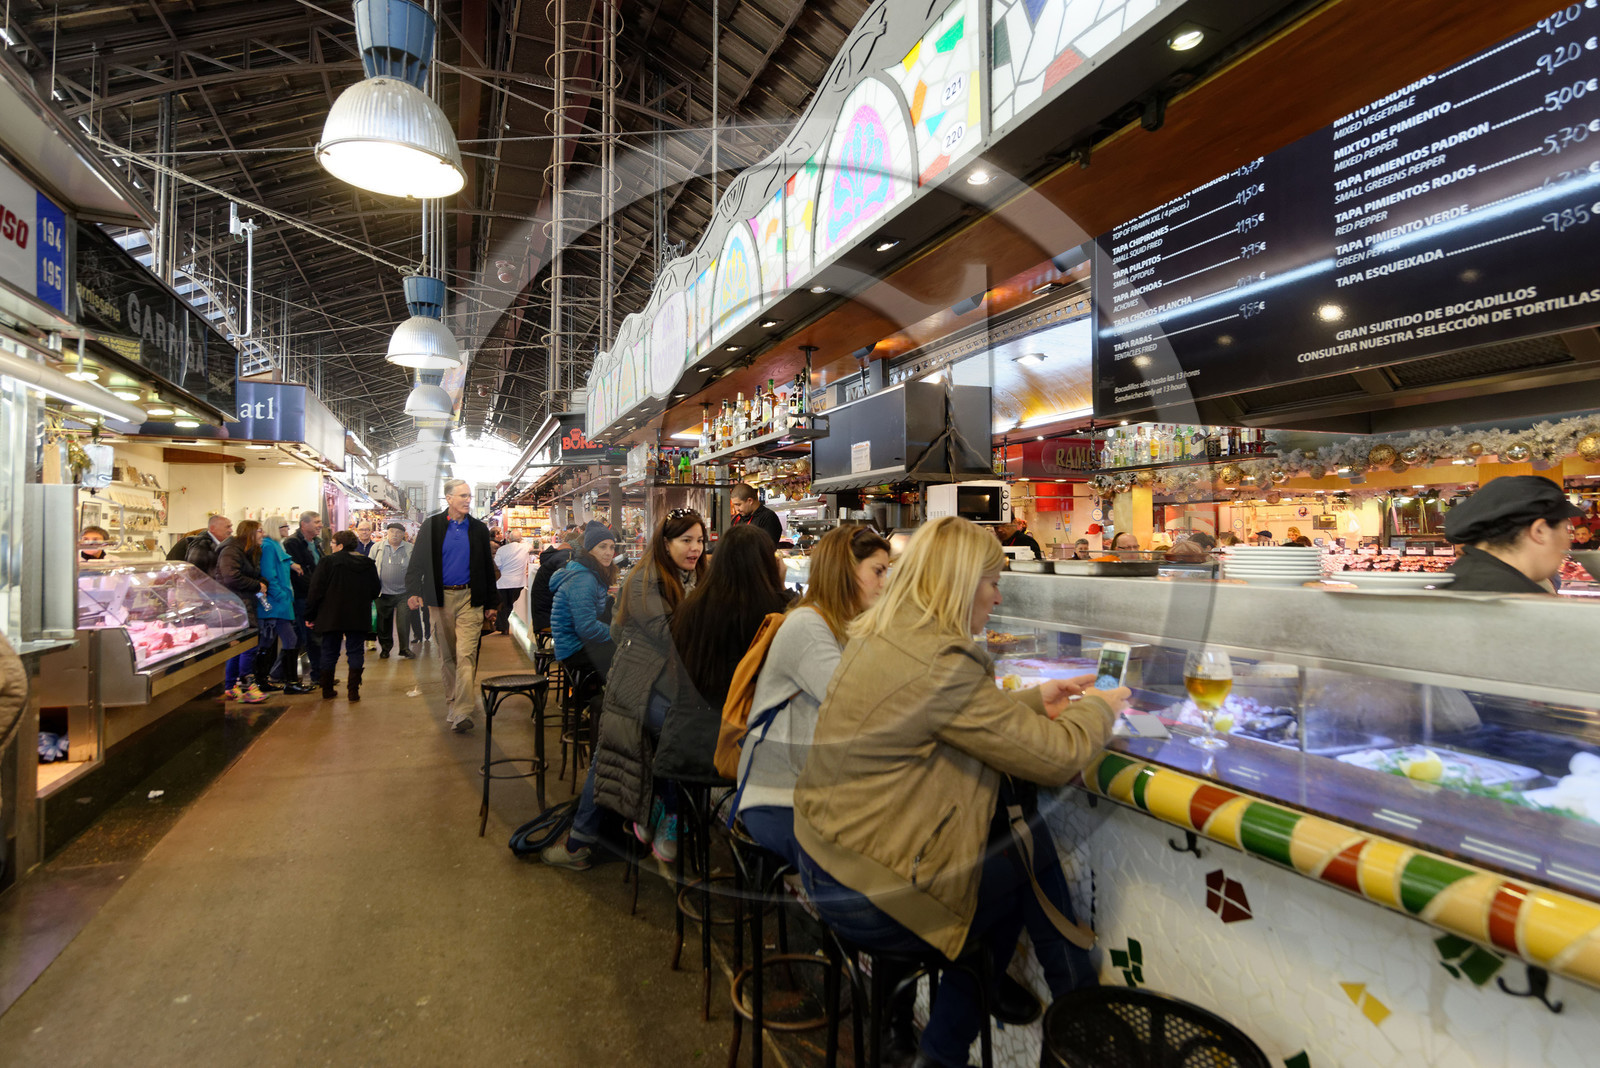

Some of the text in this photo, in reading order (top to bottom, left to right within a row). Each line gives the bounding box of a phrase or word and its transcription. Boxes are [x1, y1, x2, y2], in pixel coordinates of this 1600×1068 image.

[945, 76, 962, 101] 221
[1333, 94, 1417, 141] MIXED VEGETABLE
[1333, 137, 1371, 160] MIXTO
[1371, 128, 1389, 144] DE
[1388, 101, 1452, 136] PIMIENTO
[946, 125, 963, 148] 220
[1333, 137, 1399, 173] MIXED PEPPER
[1334, 174, 1363, 192] TAPA
[1363, 145, 1430, 181] PIMIENTOS
[1431, 121, 1490, 154] PADRON
[1334, 153, 1446, 205] SMALL GREEENS PEPPER
[1334, 206, 1363, 224] TAPA
[1364, 181, 1431, 214] PIMIENTOS
[1431, 164, 1477, 189] ROJOS
[42, 216, 61, 252] 194
[1112, 231, 1123, 241] TOP
[1122, 228, 1130, 236] OF
[1130, 218, 1151, 233] PRAWN
[1335, 210, 1388, 237] RED PEPPER
[1335, 203, 1469, 256] TAPA PIMIENTO VERDE
[1112, 243, 1129, 256] TAPA
[1129, 224, 1169, 248] CHIPIRONES
[1112, 238, 1163, 266] SMALL SQUID FRIED
[42, 256, 61, 291] 195
[1112, 267, 1129, 280] TAPA
[1128, 254, 1162, 274] PULPITOS
[1335, 251, 1366, 268] GREEN
[1335, 272, 1364, 288] TAPA
[1365, 248, 1444, 280] ESQUEIXADA
[1112, 266, 1155, 290] SMALL OPTOPUS
[1112, 292, 1129, 304] TAPA
[1129, 279, 1162, 298] ANCHOAS
[1112, 298, 1139, 314] ACHOVIES
[1112, 316, 1130, 328] TAPA
[1130, 306, 1158, 322] CHOCOS
[1158, 295, 1193, 313] PLANCHA
[1335, 286, 1537, 341] GRAN SURTIDO DE BOCADILLOS
[1297, 288, 1600, 363] CONSULTAR NUESTRA SELECCIÓN DE TORTILLAS
[1113, 341, 1130, 352] TAPA
[1130, 334, 1153, 348] RABAS
[1113, 343, 1158, 361] TENTACLES FRIED
[1151, 376, 1166, 385] hasta
[1166, 374, 1175, 382] las
[1176, 372, 1184, 380] 13
[1183, 369, 1200, 379] horas
[1114, 391, 1144, 404] Sandwiches
[1144, 388, 1155, 397] only
[1163, 385, 1170, 393] 13
[1170, 382, 1187, 391] hours
